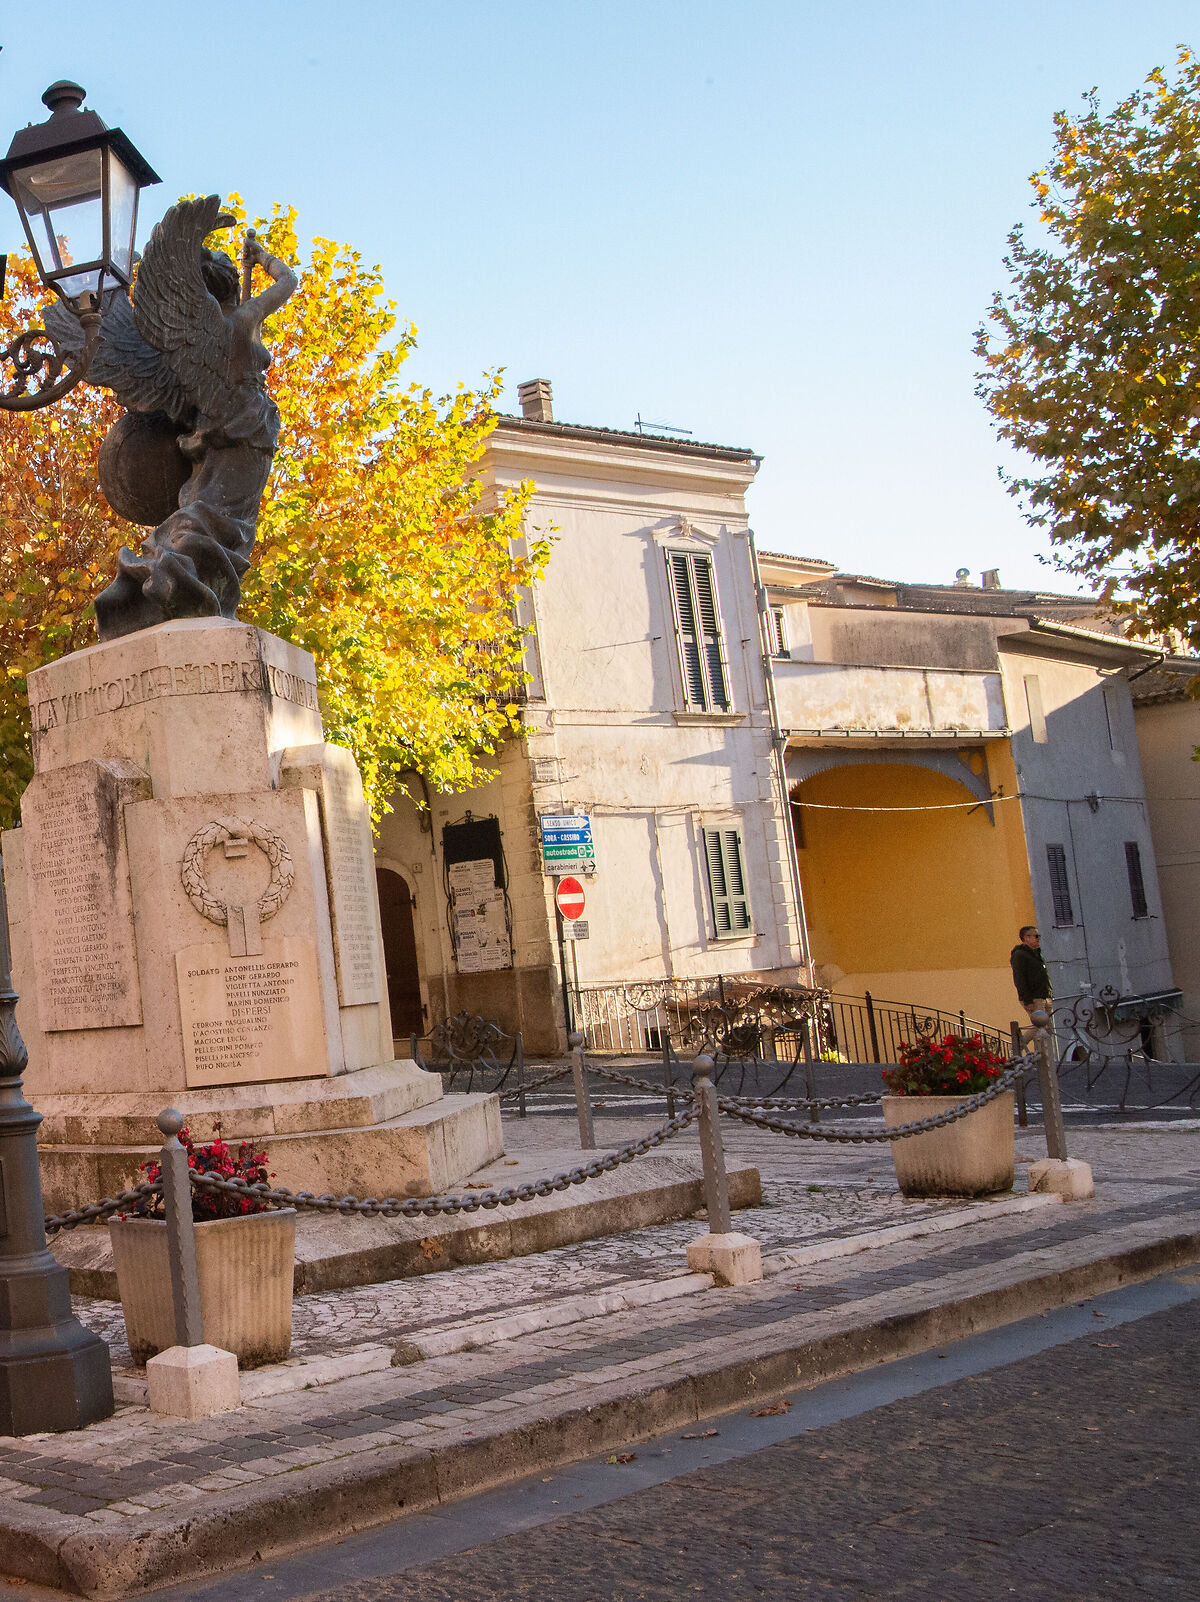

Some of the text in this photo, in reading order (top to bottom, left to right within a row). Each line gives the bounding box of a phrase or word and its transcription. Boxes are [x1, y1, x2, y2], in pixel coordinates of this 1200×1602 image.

[546, 818, 577, 827] SENSO UNICO
[546, 848, 577, 856] autostrada
[188, 961, 299, 978] SOLDATO ANTONELLIS GERARDO
[225, 972, 281, 983] LEONE GERARDO
[226, 979, 295, 991] VIGLIETTA ANTONIO
[251, 988, 286, 997] NUNZIATO
[227, 996, 290, 1008] MARINI DOMENICO
[232, 1005, 272, 1017] DISPERSI
